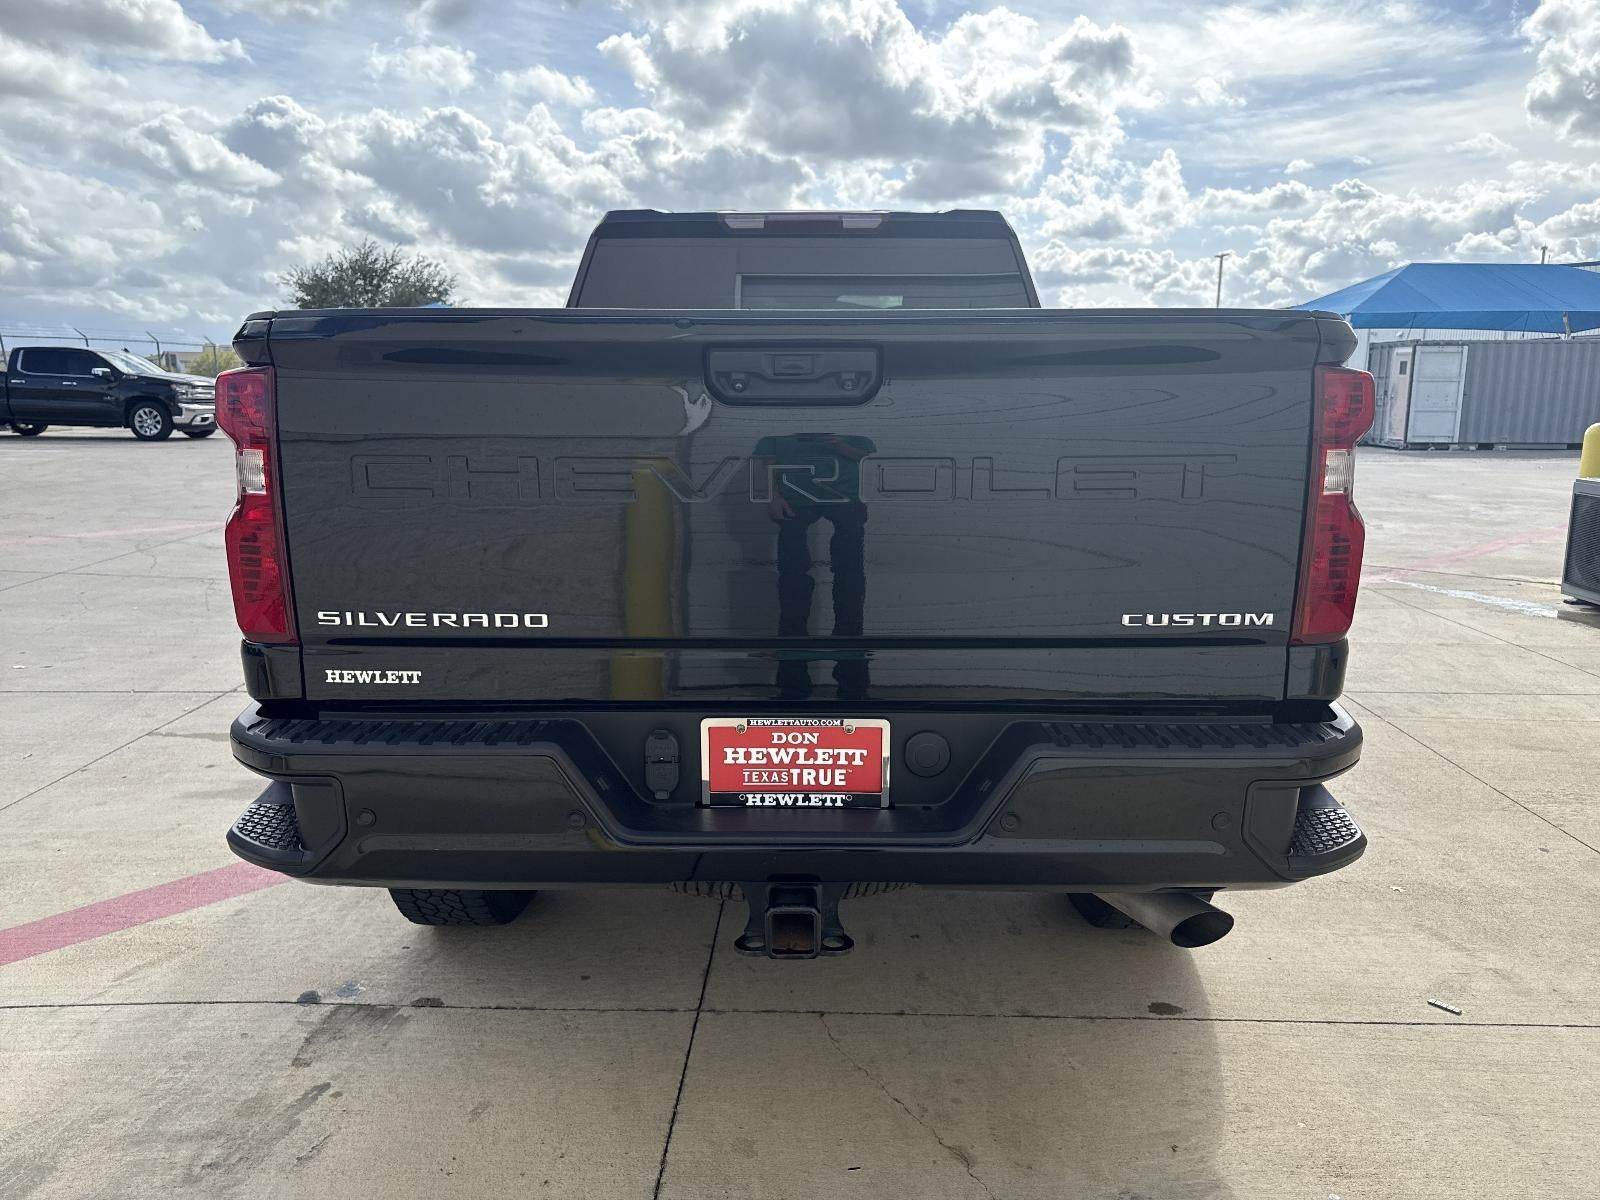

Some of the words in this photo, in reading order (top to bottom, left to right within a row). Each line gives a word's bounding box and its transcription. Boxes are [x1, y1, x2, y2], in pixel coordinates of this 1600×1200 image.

[350, 454, 1238, 503] CHEVROLET
[317, 611, 549, 628] SILVERADO
[1121, 613, 1274, 626] CUSTOM
[324, 669, 422, 684] HEWLETT
[771, 732, 820, 745] DON
[723, 747, 868, 766] HEWLETT
[745, 793, 846, 807] HEWLETT
